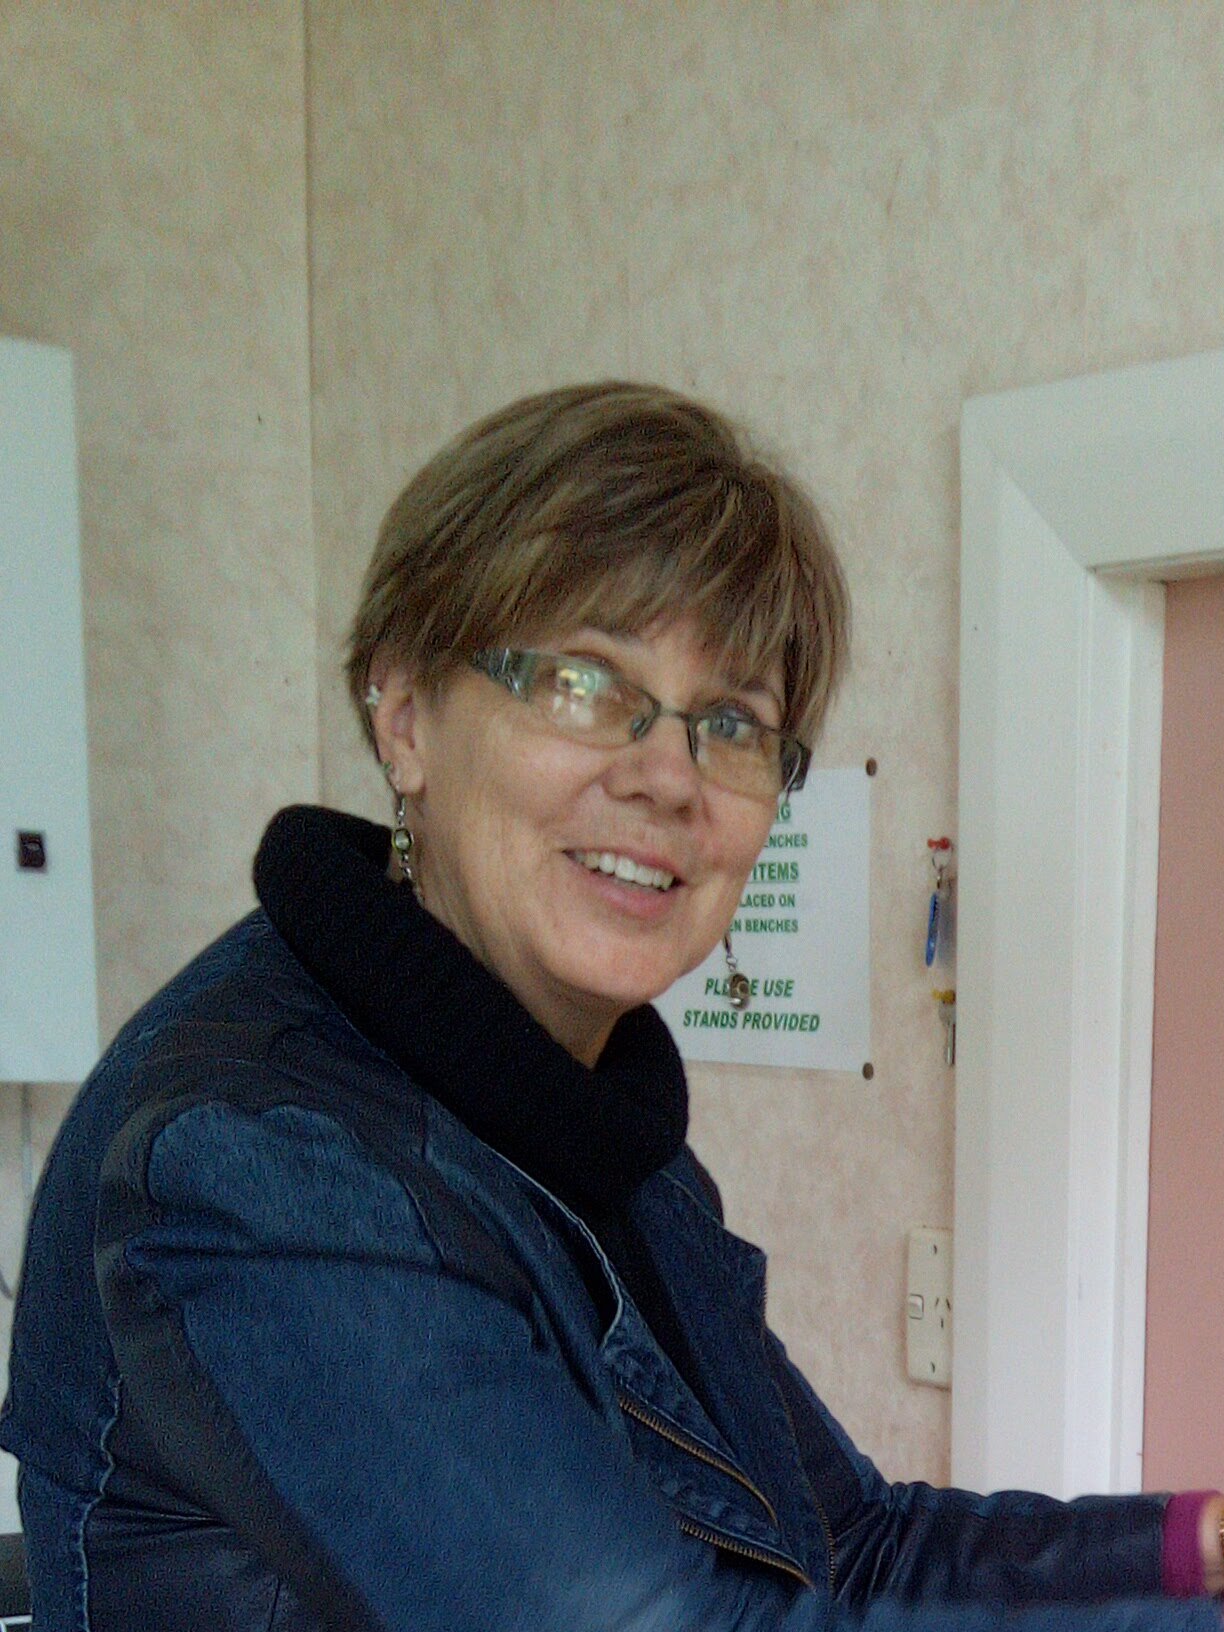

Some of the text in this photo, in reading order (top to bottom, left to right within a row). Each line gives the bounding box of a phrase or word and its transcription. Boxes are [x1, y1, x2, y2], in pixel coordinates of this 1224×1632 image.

[764, 833, 808, 848] NCHES
[778, 894, 796, 908] ON
[745, 919, 799, 933] BENCHES
[763, 980, 795, 998] USE
[683, 1010, 820, 1033] STANDS PROVIDED
